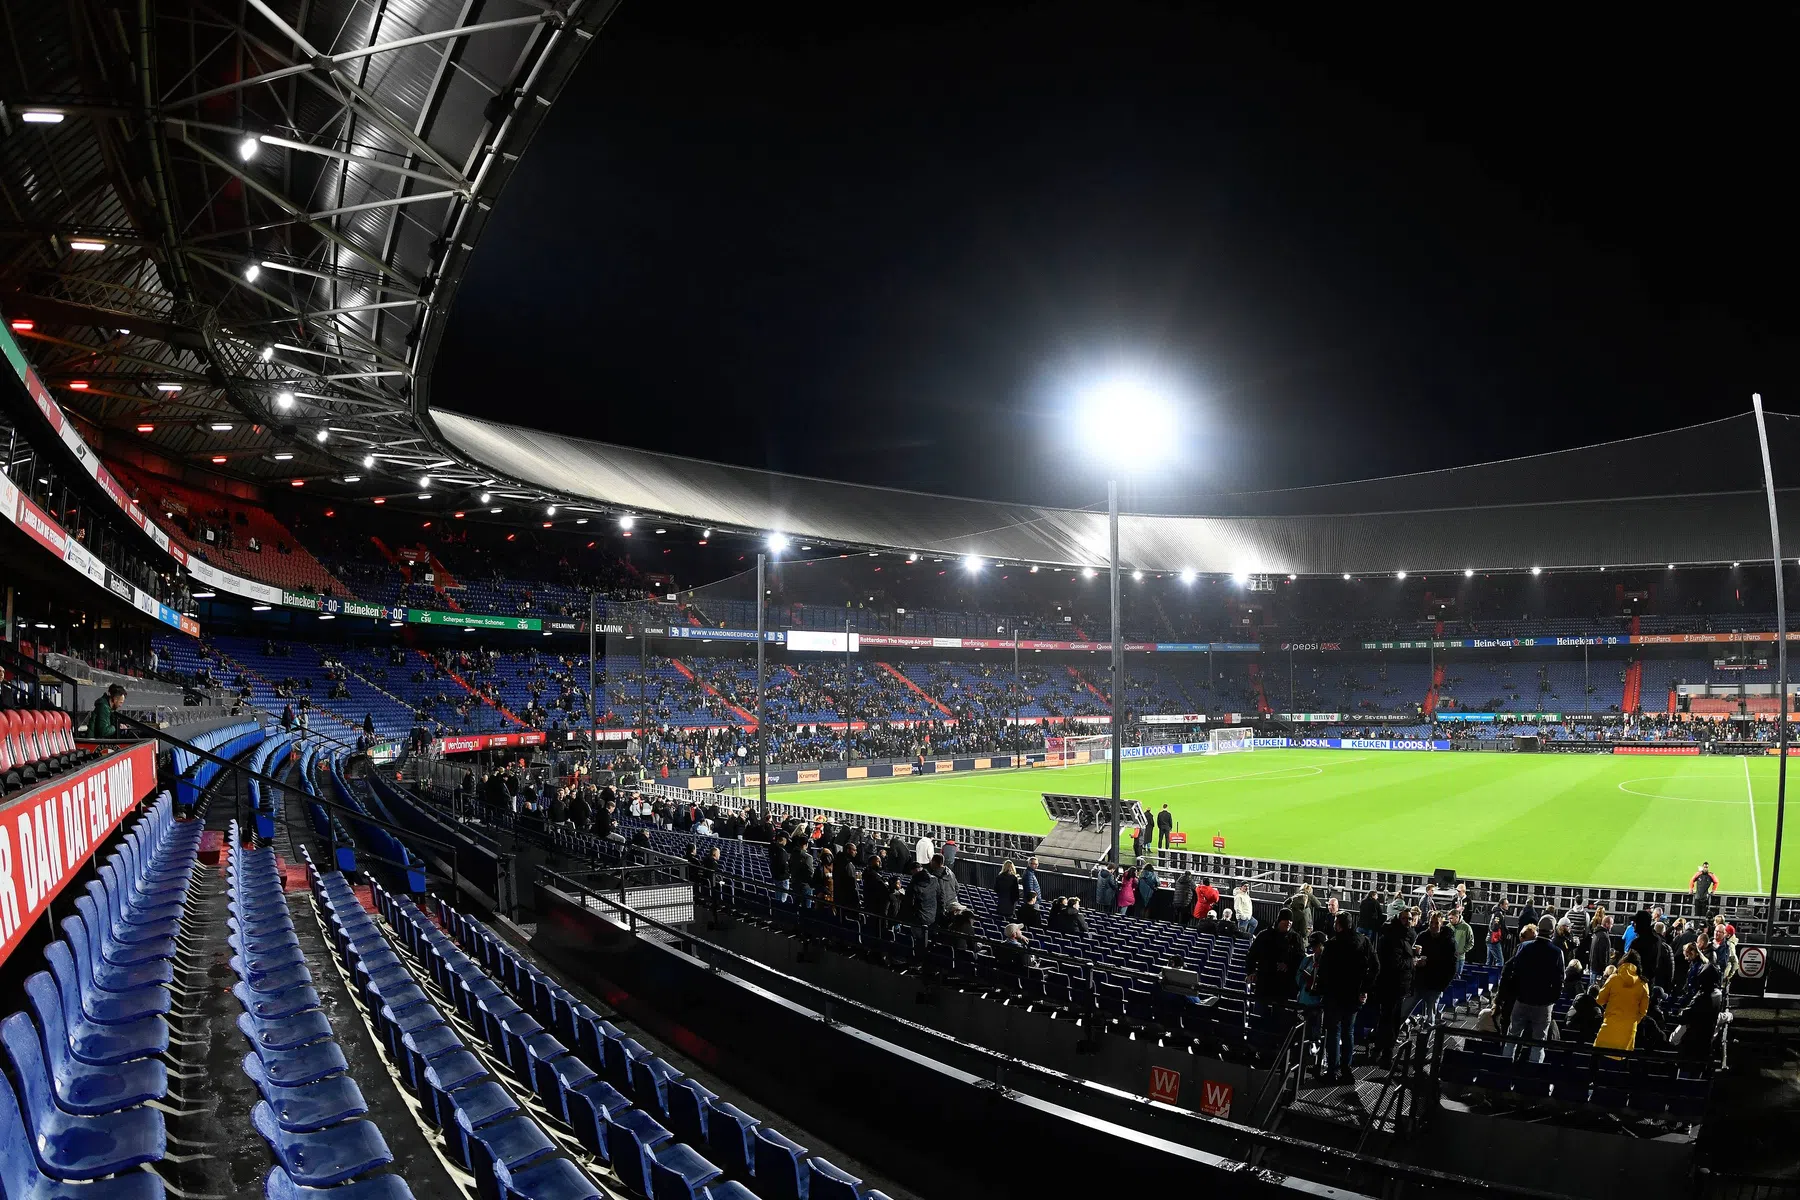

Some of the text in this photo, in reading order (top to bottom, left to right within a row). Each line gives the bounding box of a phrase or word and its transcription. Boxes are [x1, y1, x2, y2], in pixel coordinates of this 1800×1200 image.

[283, 591, 316, 609] Heineken
[344, 602, 380, 616] Heineken
[595, 624, 623, 633] ELMINK
[914, 638, 932, 646] Airport
[1474, 639, 1511, 647] Heineken
[1557, 637, 1594, 646] Heineken
[1292, 643, 1318, 651] pepsi
[1352, 740, 1386, 748] KEUKEN
[1121, 746, 1175, 757] UKEN LOODS.NL
[18, 797, 63, 914] DAN
[62, 783, 88, 871] DAT
[87, 770, 110, 843] ENE
[107, 757, 133, 824] WOORD
[1154, 1069, 1177, 1094] W
[1207, 1083, 1229, 1107] W
